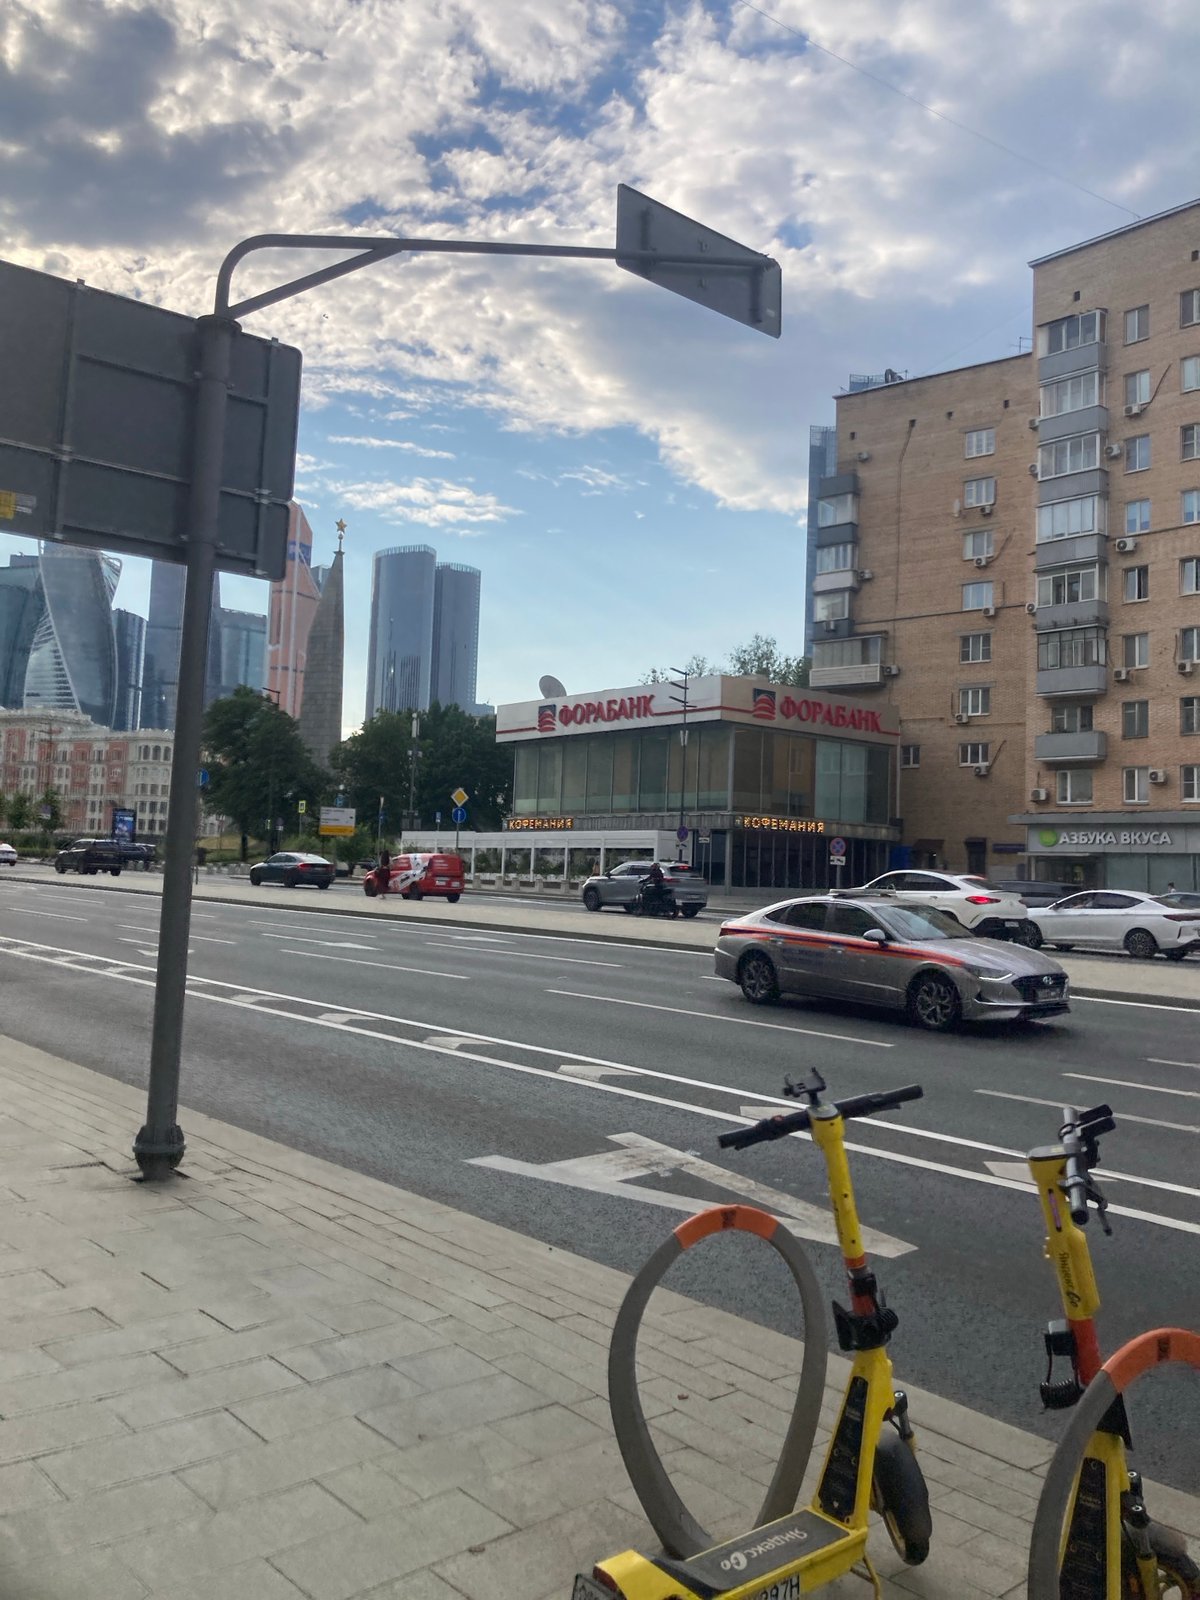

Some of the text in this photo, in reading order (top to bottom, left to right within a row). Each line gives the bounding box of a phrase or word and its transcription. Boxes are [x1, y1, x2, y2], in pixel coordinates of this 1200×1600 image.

[559, 694, 655, 727] ФОРАБАНК
[780, 696, 881, 732] ФОРАБАНК
[509, 818, 574, 830] КОФЕМАНИЯ
[743, 816, 824, 833] КОФЕМАНИЯ
[1059, 831, 1172, 845] АЗБУКА ВКУСА
[720, 1527, 808, 1571] Яндекс Go
